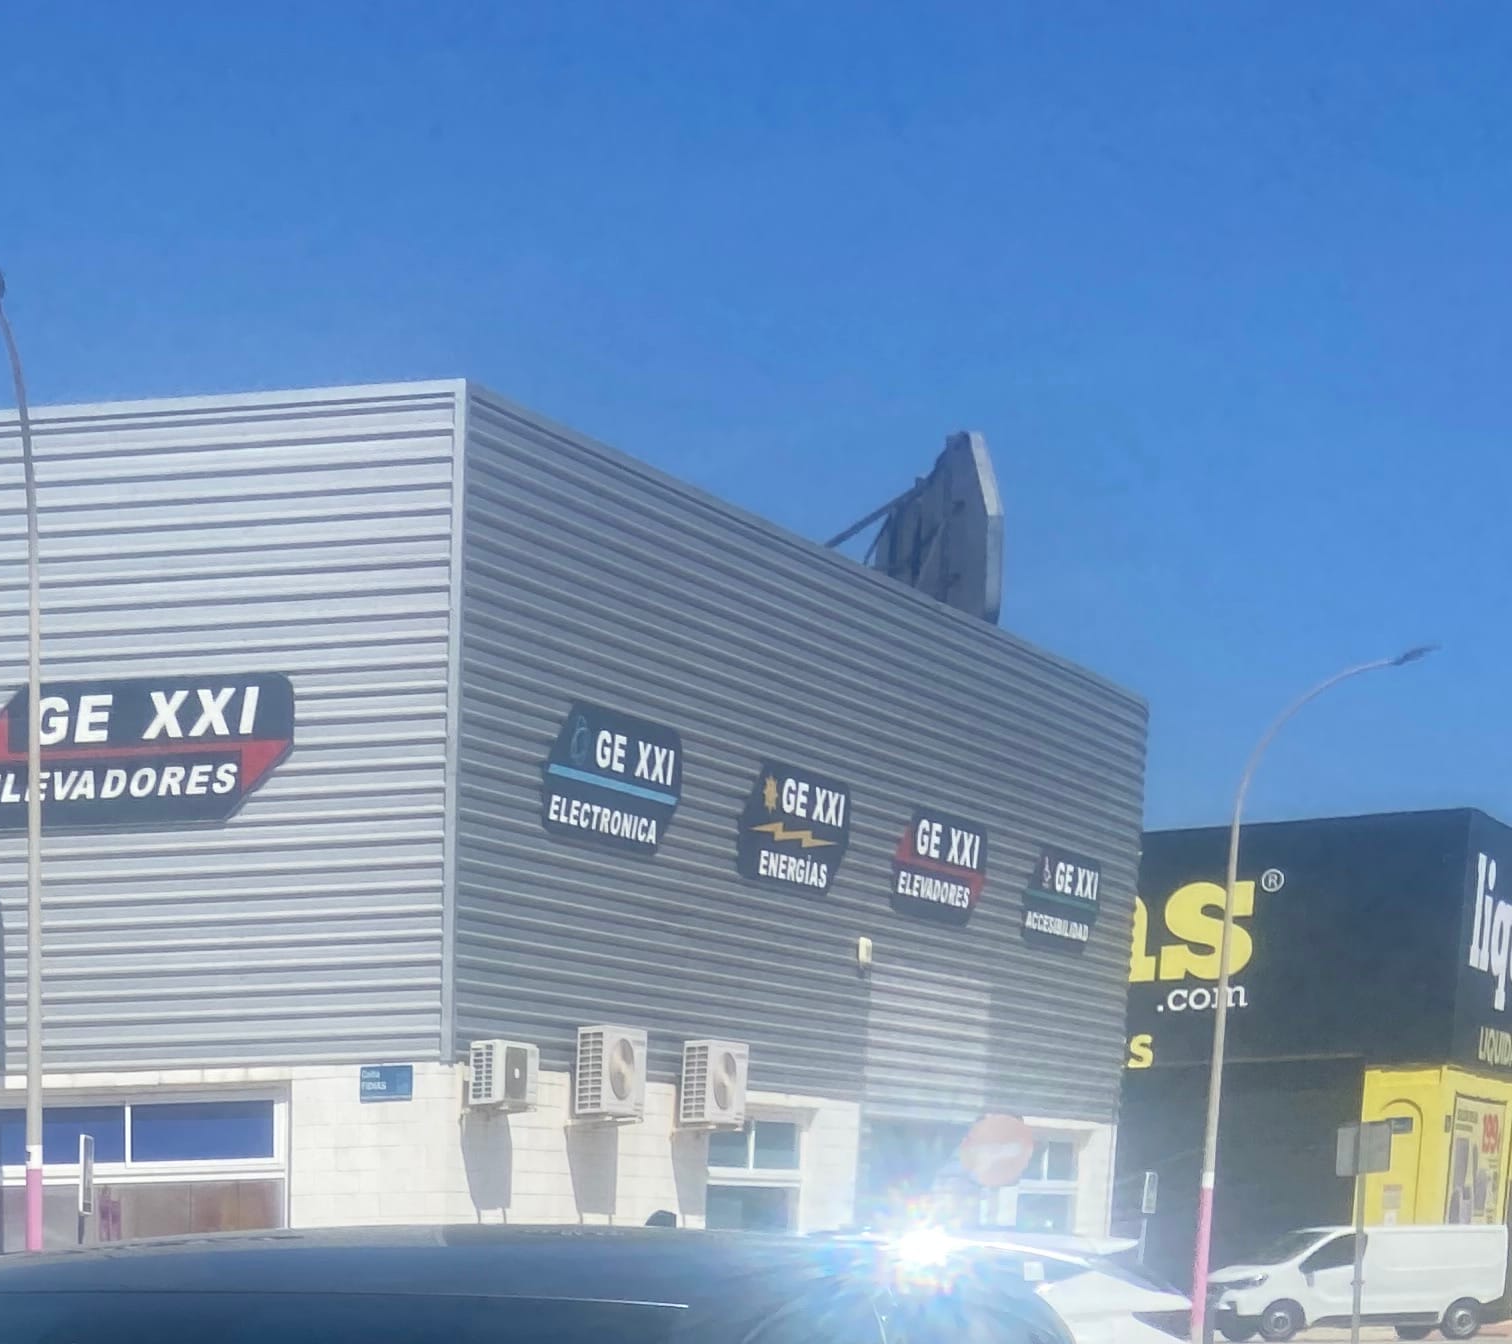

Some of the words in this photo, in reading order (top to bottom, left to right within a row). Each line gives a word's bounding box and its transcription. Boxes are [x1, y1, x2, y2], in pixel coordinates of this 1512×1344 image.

[39, 694, 114, 746] GE
[142, 686, 261, 740] XXI
[595, 729, 628, 773] GE
[634, 740, 676, 786] XXI
[548, 794, 657, 845] ELECTRONICA
[782, 777, 810, 818] GE
[812, 786, 847, 828] XXI
[916, 818, 942, 859] GE
[946, 827, 981, 870] XXI
[758, 849, 829, 889] ENERGÍAS
[897, 870, 971, 909] ELEVADORES
[1054, 861, 1074, 894] GE
[1074, 866, 1100, 901] XXI
[1024, 910, 1090, 943] ACCESIBILIDAD
[1469, 852, 1512, 1011] liq
[1156, 985, 1249, 1013] .com
[1478, 1025, 1512, 1067] LIQUID
